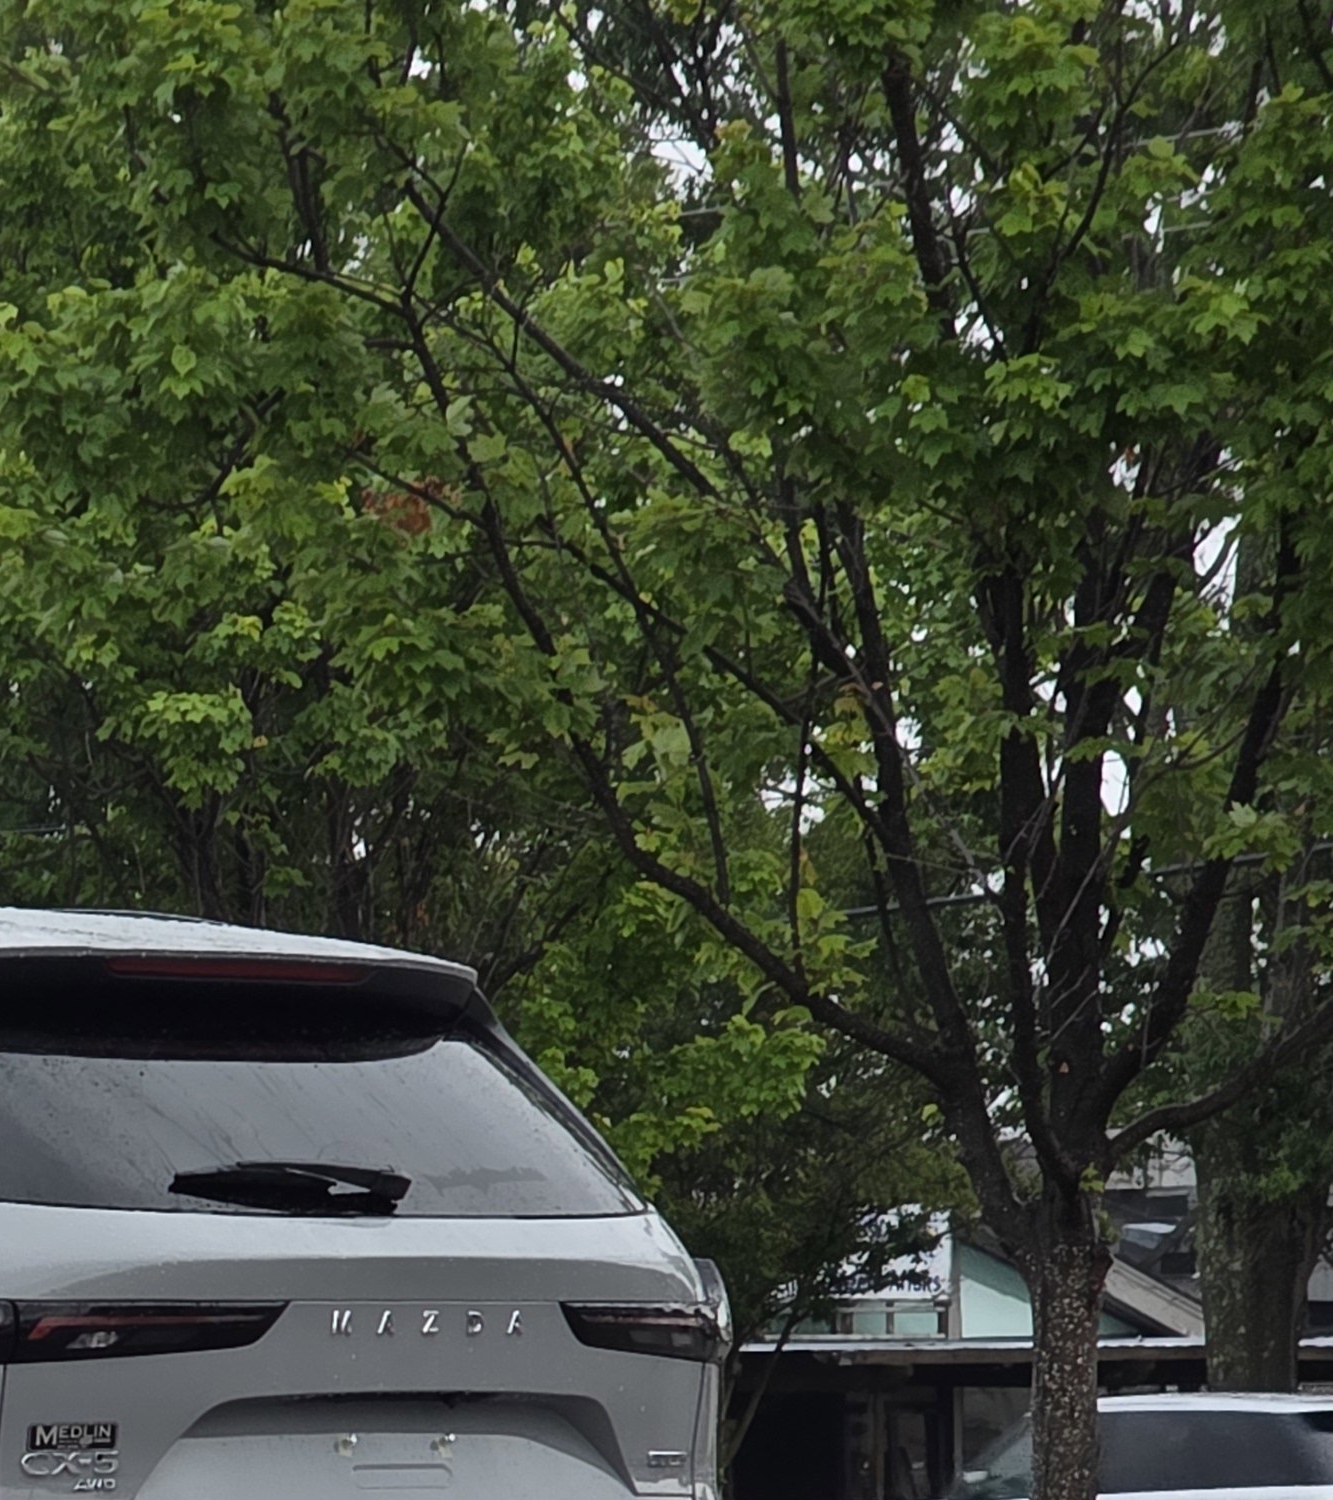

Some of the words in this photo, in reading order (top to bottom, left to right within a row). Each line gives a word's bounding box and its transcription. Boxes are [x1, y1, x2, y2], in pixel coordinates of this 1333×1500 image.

[332, 1310, 523, 1334] MAZDA
[35, 1424, 111, 1446] MEDLIN
[21, 1450, 119, 1475] CX-5
[73, 1478, 117, 1491] AWD
